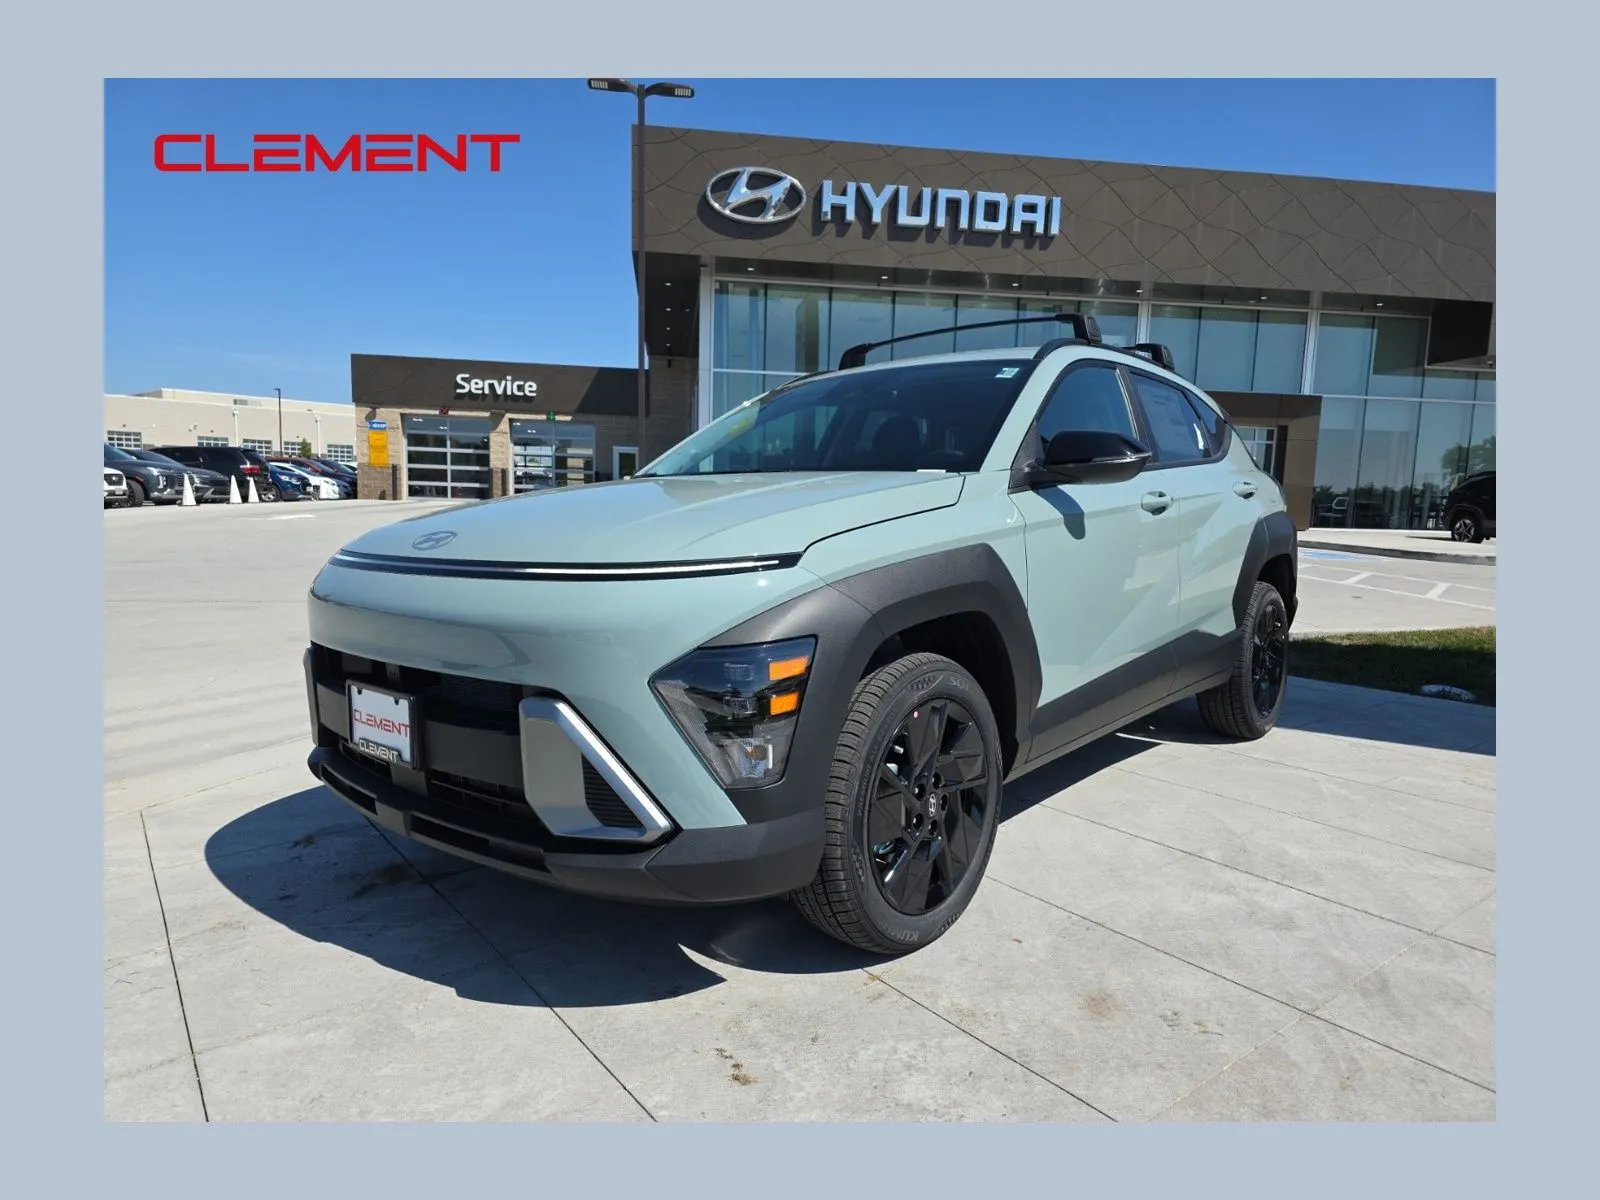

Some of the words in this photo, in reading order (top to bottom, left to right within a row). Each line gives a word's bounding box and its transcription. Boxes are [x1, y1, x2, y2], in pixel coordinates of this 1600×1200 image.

[820, 179, 1063, 238] HYUNDAI
[455, 373, 538, 397] Service
[352, 708, 412, 738] CLEMENT
[359, 739, 398, 763] CLEMENT
